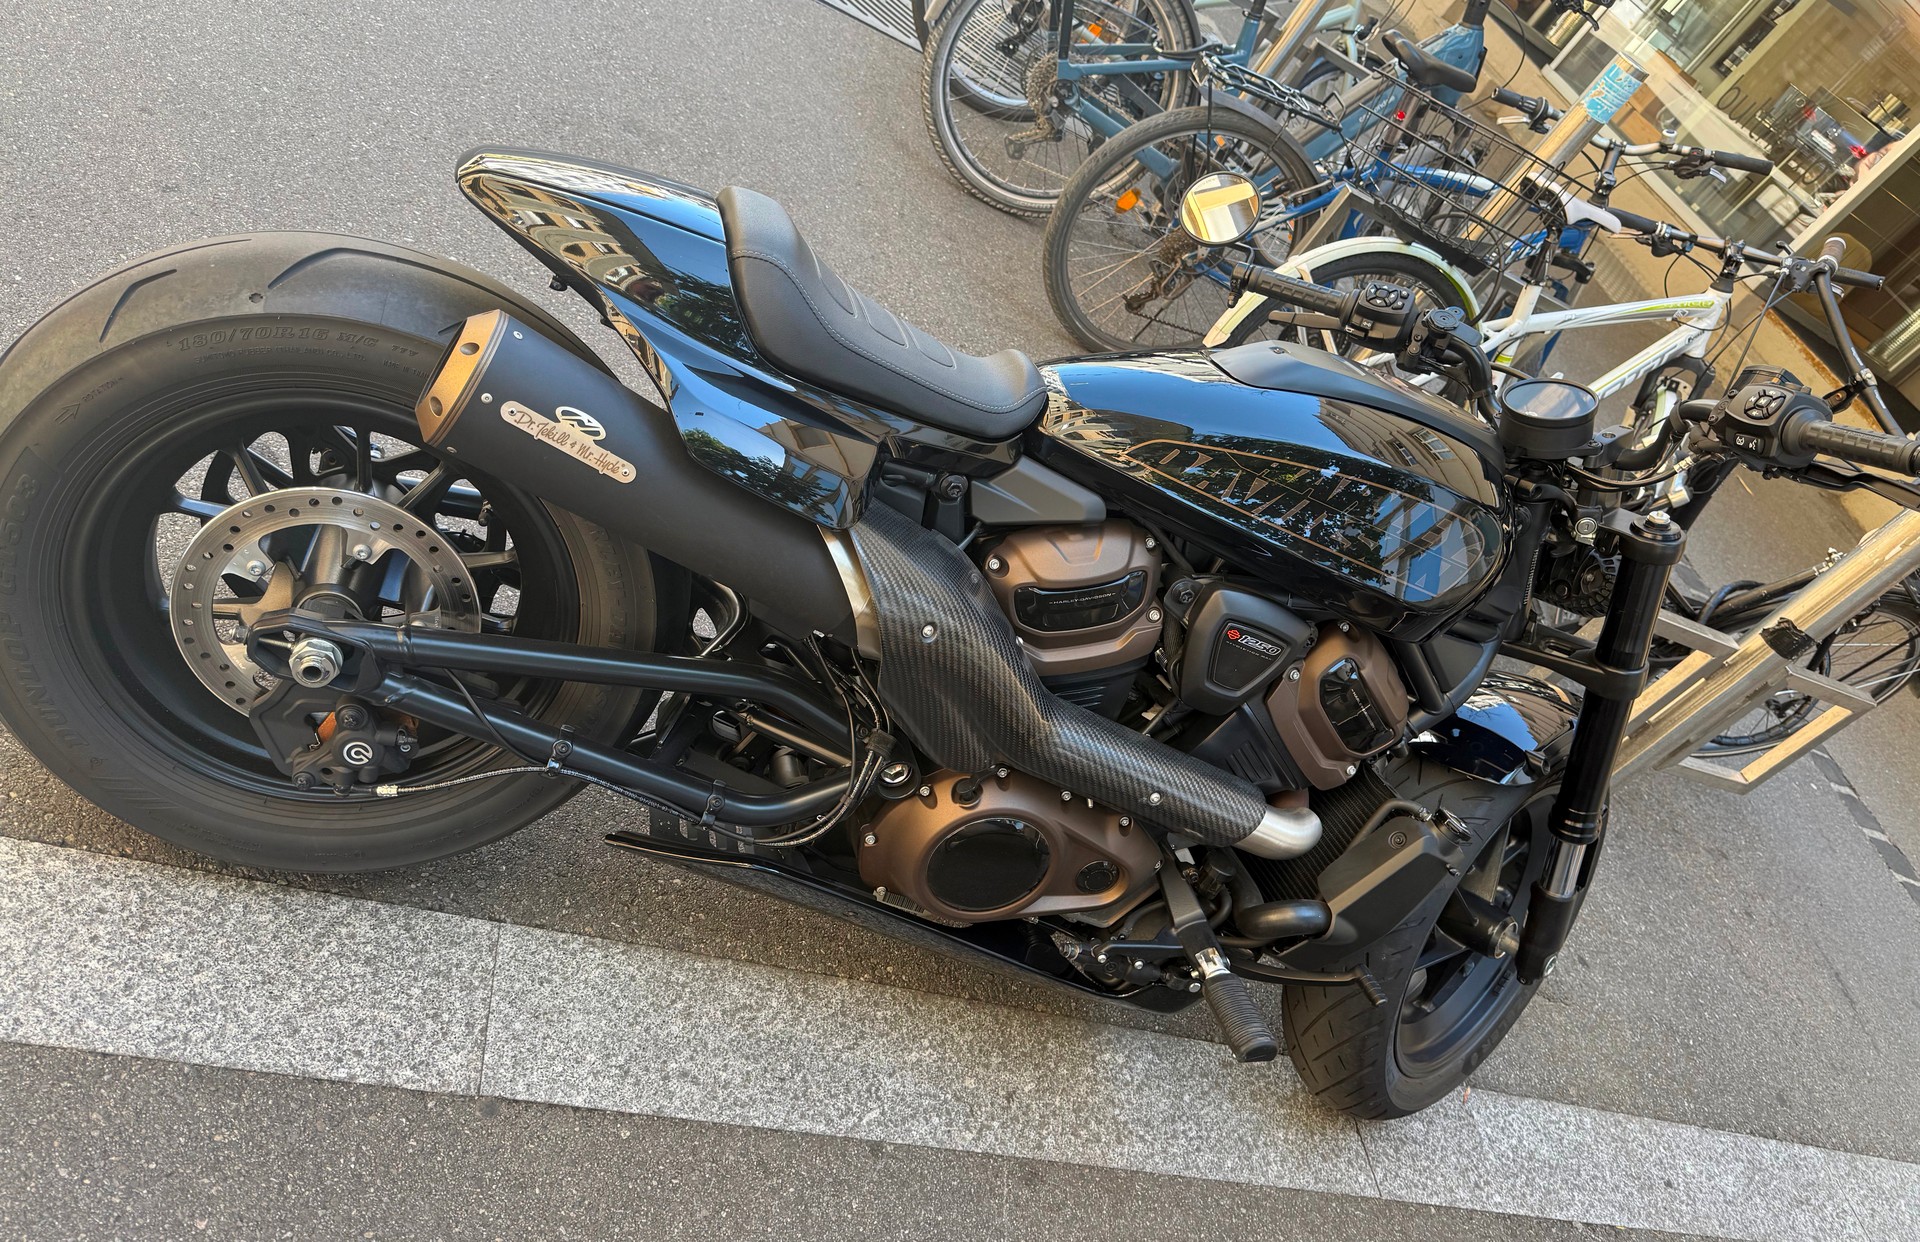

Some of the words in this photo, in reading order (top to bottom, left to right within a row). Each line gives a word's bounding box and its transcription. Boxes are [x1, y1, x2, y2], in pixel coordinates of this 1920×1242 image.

[178, 326, 330, 352] 180/70R16
[514, 410, 535, 431] Dr.
[535, 421, 571, 447] Jekill
[576, 443, 593, 462] Mr.
[1237, 634, 1282, 656] 1250
